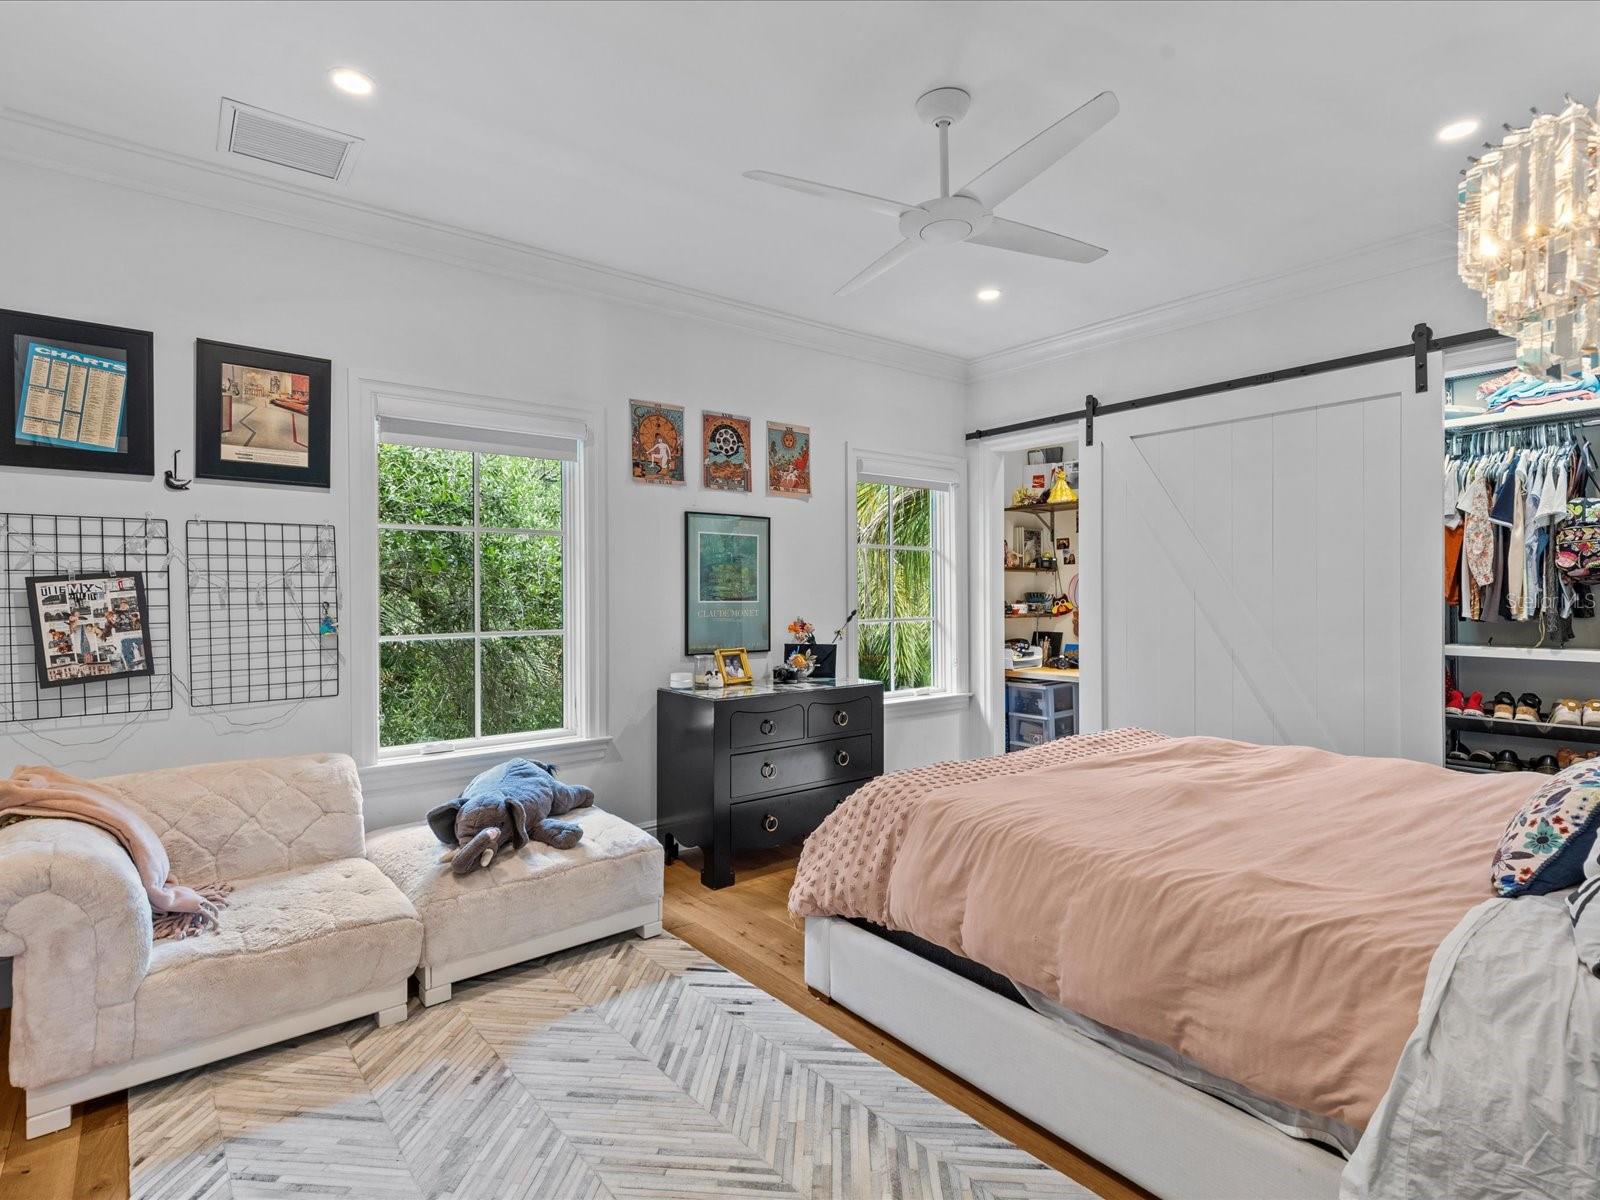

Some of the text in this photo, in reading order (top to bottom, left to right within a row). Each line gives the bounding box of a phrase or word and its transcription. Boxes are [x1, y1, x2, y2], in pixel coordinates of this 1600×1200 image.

[34, 346, 127, 372] CHARTS
[697, 608, 760, 617] CLAUDE MONET
